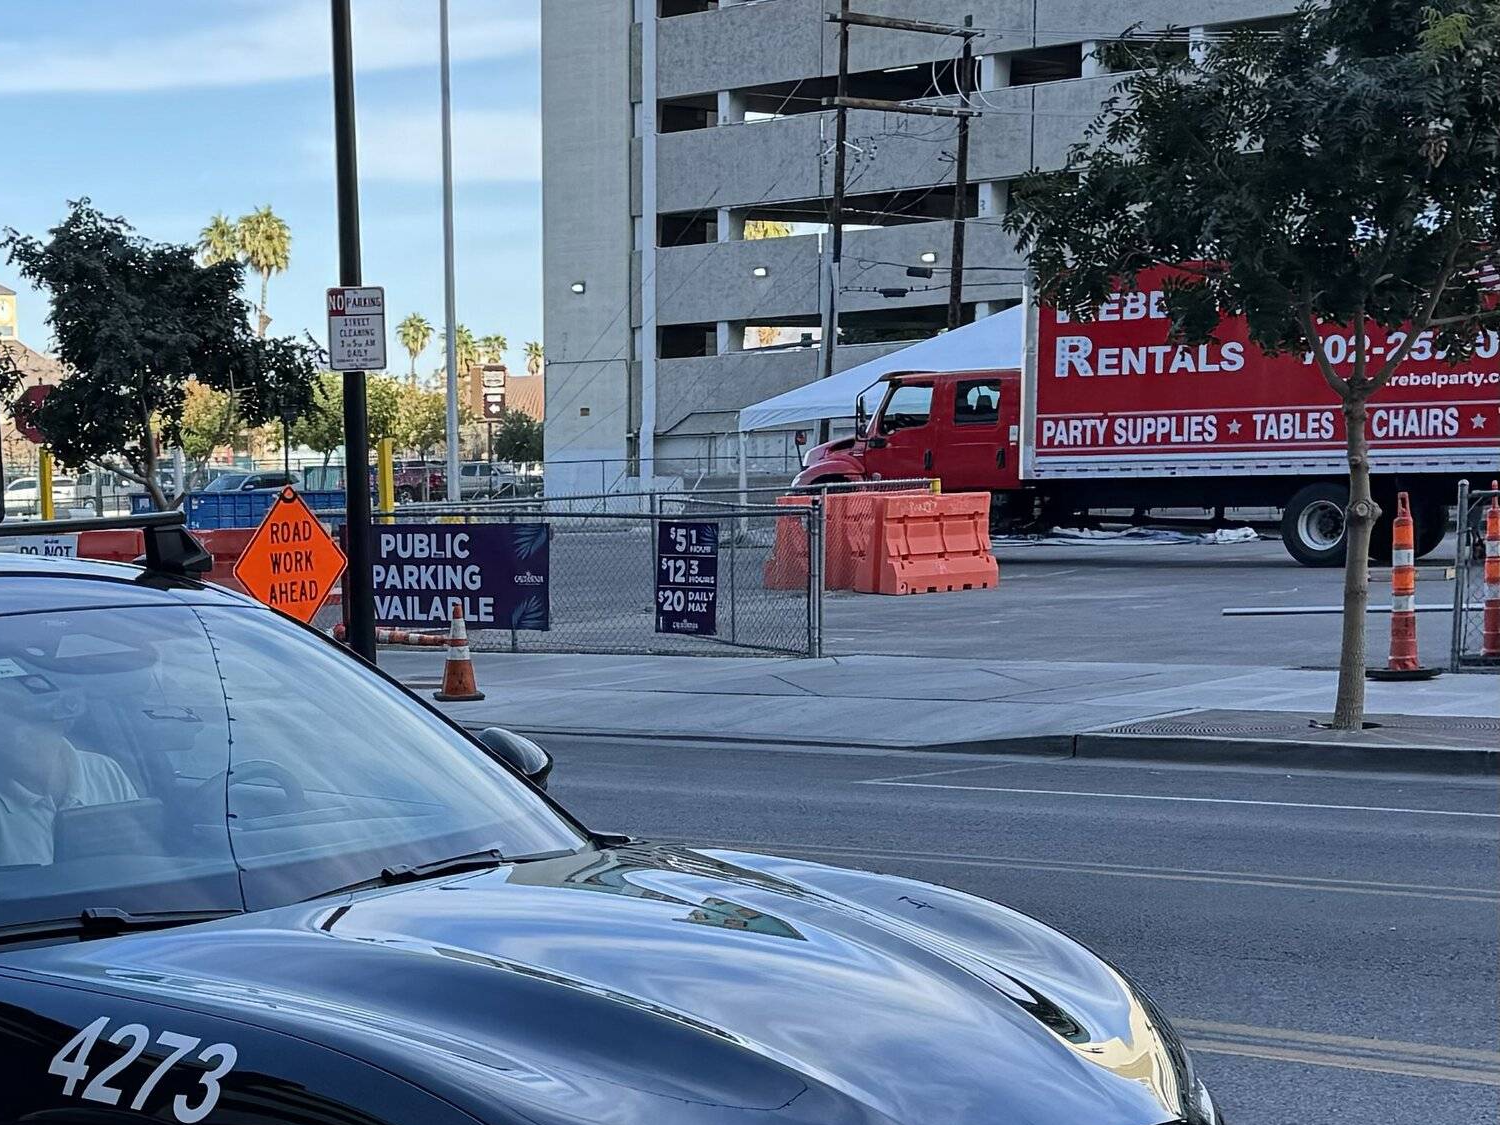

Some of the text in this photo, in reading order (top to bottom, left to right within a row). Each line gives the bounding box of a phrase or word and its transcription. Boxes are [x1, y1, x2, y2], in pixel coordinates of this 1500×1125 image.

[328, 294, 382, 311] NO PARKING
[340, 328, 375, 338] CLEANING
[344, 317, 370, 327] STREET
[1055, 335, 1245, 378] RENTALS
[1042, 406, 1459, 446] PARTY SUPPLIES TABLES CHAIRS
[270, 520, 312, 544] ROAD
[670, 527, 687, 552] $5
[690, 529, 697, 544] 1
[20, 545, 73, 557] DO NOT
[380, 532, 470, 559] PUBLIC
[690, 545, 711, 553] HOUR
[270, 550, 314, 575] WORK
[661, 558, 686, 583] $12
[689, 560, 699, 575] 3
[372, 564, 481, 591] PARKING
[688, 576, 714, 584] HOURS
[269, 580, 318, 605] AHEAD
[658, 590, 685, 612] $20
[688, 592, 714, 601] DAILY
[687, 603, 707, 612] MAX
[47, 1016, 238, 1124] 4273
